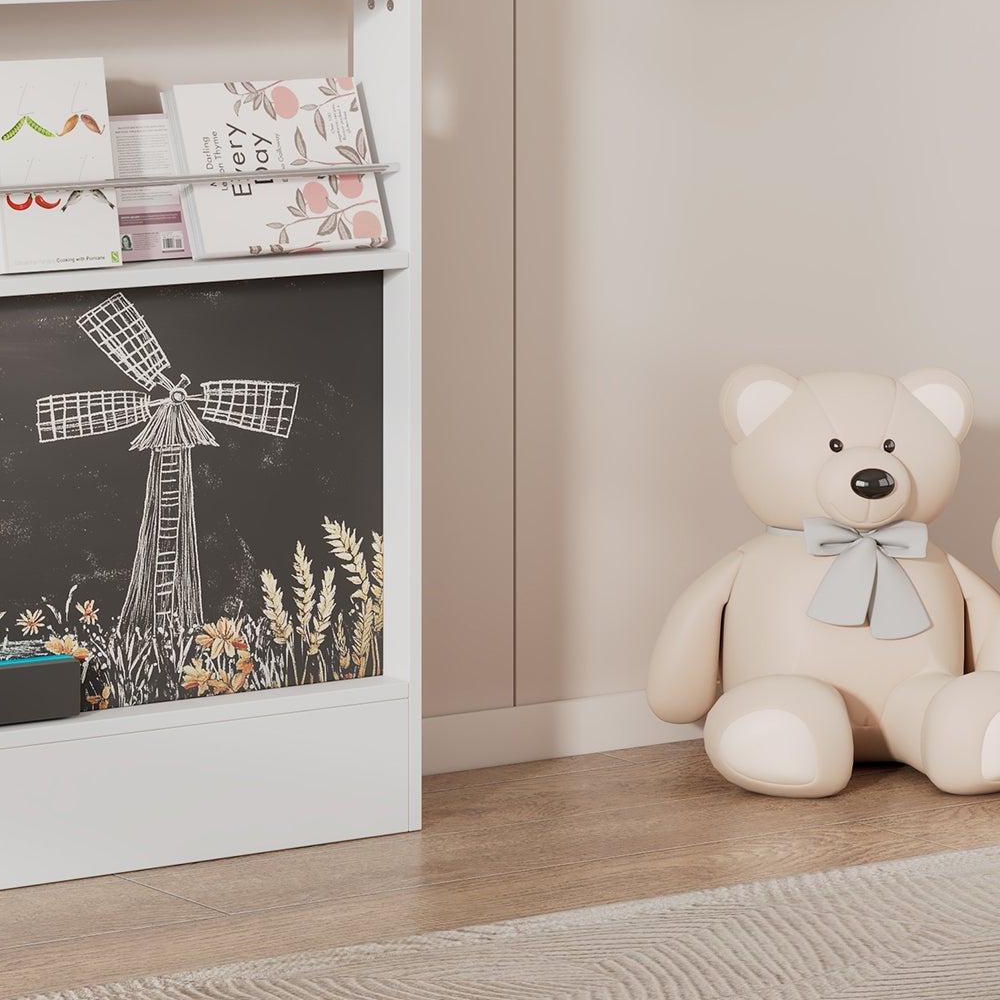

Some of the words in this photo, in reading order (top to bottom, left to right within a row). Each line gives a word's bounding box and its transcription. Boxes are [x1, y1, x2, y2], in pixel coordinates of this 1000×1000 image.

[203, 136, 214, 170] Darling
[212, 130, 223, 160] Thyme
[218, 162, 229, 192] Leon
